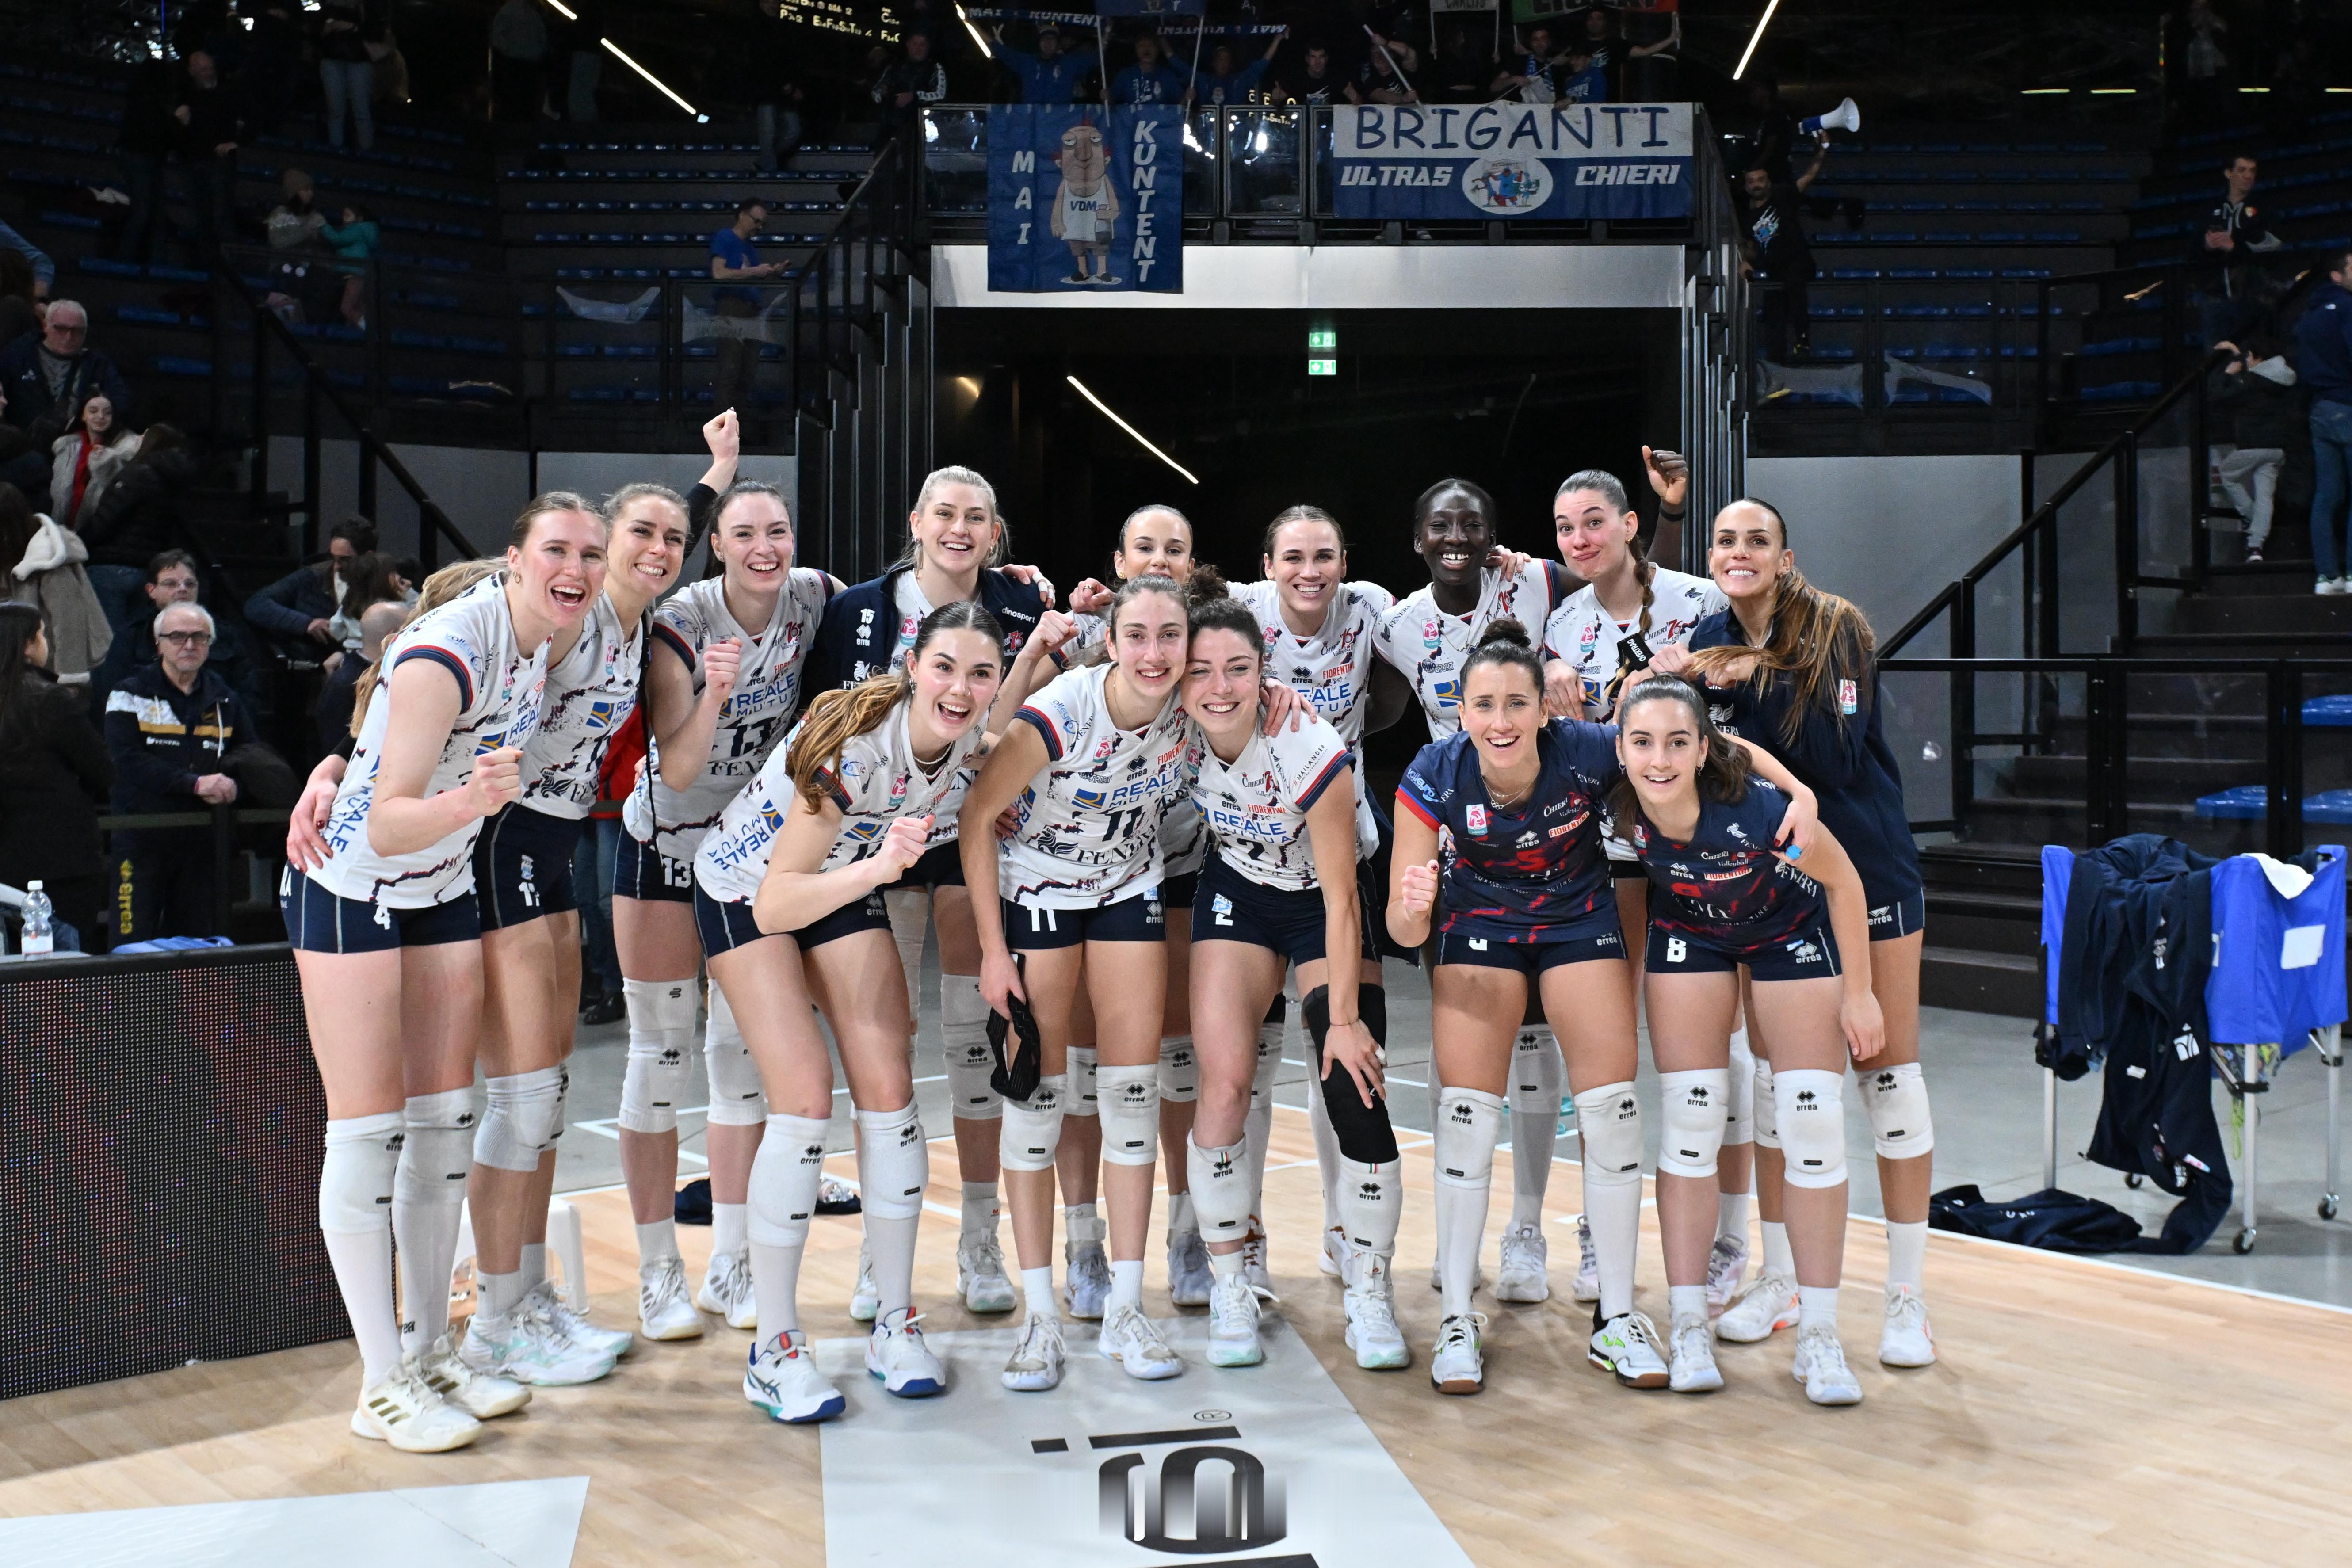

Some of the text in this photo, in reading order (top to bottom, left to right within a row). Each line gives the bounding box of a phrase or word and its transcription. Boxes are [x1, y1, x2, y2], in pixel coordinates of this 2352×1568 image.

[1356, 106, 1669, 150] BRIGANTI
[1340, 164, 1680, 186] ULTRAS CHIERI
[1012, 120, 1157, 282] MAI KUNTENT
[1070, 201, 1097, 211] VDM
[860, 608, 875, 624] 15
[1001, 607, 1035, 624] dinosport
[737, 672, 795, 709] REALE
[1297, 683, 1351, 702] EALE
[1314, 699, 1352, 713] TUA
[509, 705, 539, 740] REAL
[1297, 744, 1325, 781] MAILANDER
[1112, 761, 1183, 801] REALE
[1126, 768, 1148, 782] errea
[1109, 784, 1174, 809] MUTU
[1222, 801, 1241, 812] errea
[1214, 810, 1287, 836] REALE
[713, 826, 771, 870] REALE
[1516, 839, 1539, 849] errea
[662, 857, 692, 888] 13
[1670, 870, 1695, 880] errea
[118, 881, 134, 934] errea
[1027, 906, 1057, 932] 11
[1146, 915, 1164, 924] errea
[1868, 913, 1893, 925] errea
[1596, 936, 1618, 946] errea
[1795, 953, 1822, 964] errea
[1172, 1059, 1191, 1068] errea
[1877, 1083, 1898, 1092] errea
[1687, 1098, 1708, 1107] errea
[1451, 1115, 1472, 1125] errea
[1619, 1109, 1637, 1120] errea
[900, 1133, 918, 1148] errea
[1213, 1167, 1233, 1178] errea
[1359, 1192, 1381, 1201] errea
